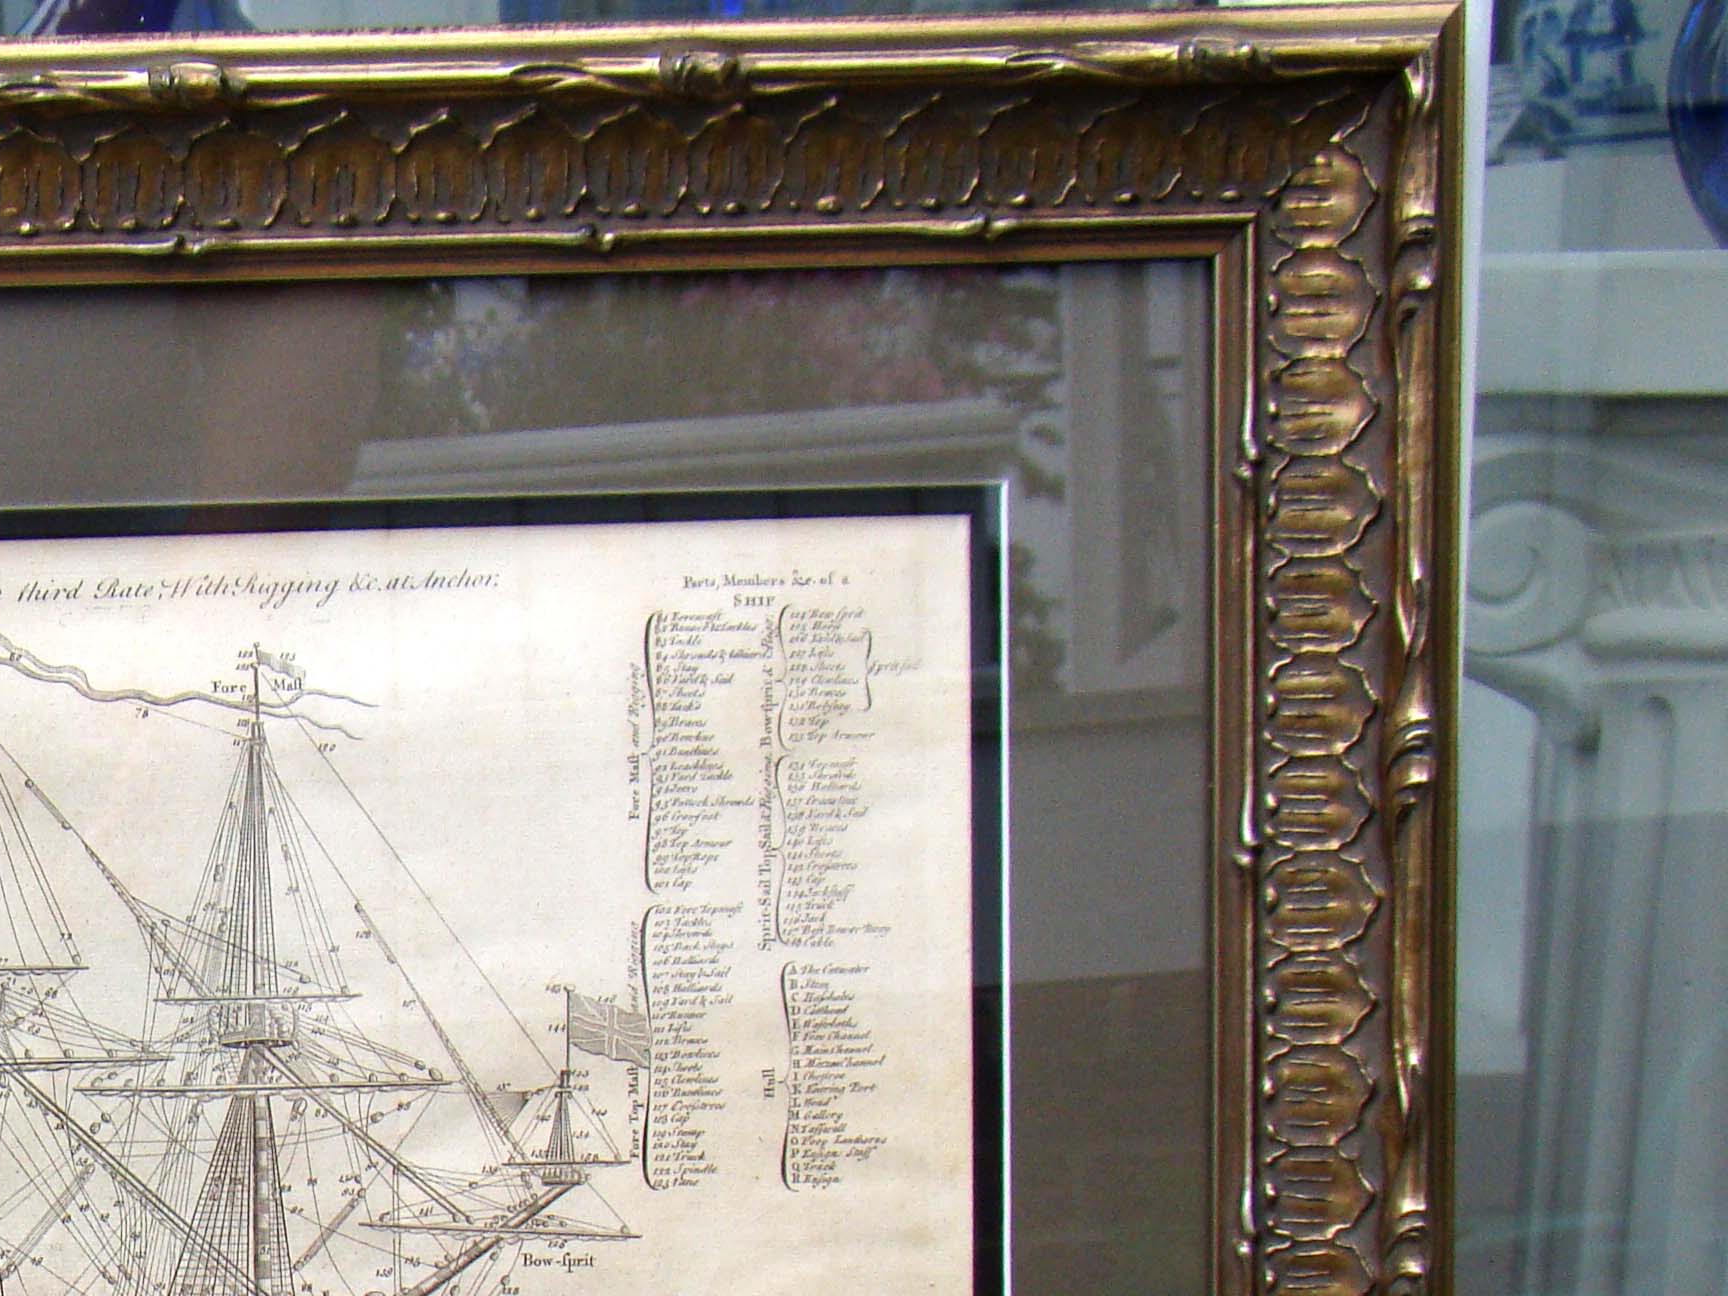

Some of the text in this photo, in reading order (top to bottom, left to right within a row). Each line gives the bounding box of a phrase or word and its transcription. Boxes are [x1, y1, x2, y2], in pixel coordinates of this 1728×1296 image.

[17, 579, 82, 602] third
[232, 573, 339, 609] Rigging
[212, 680, 246, 695] Fore
